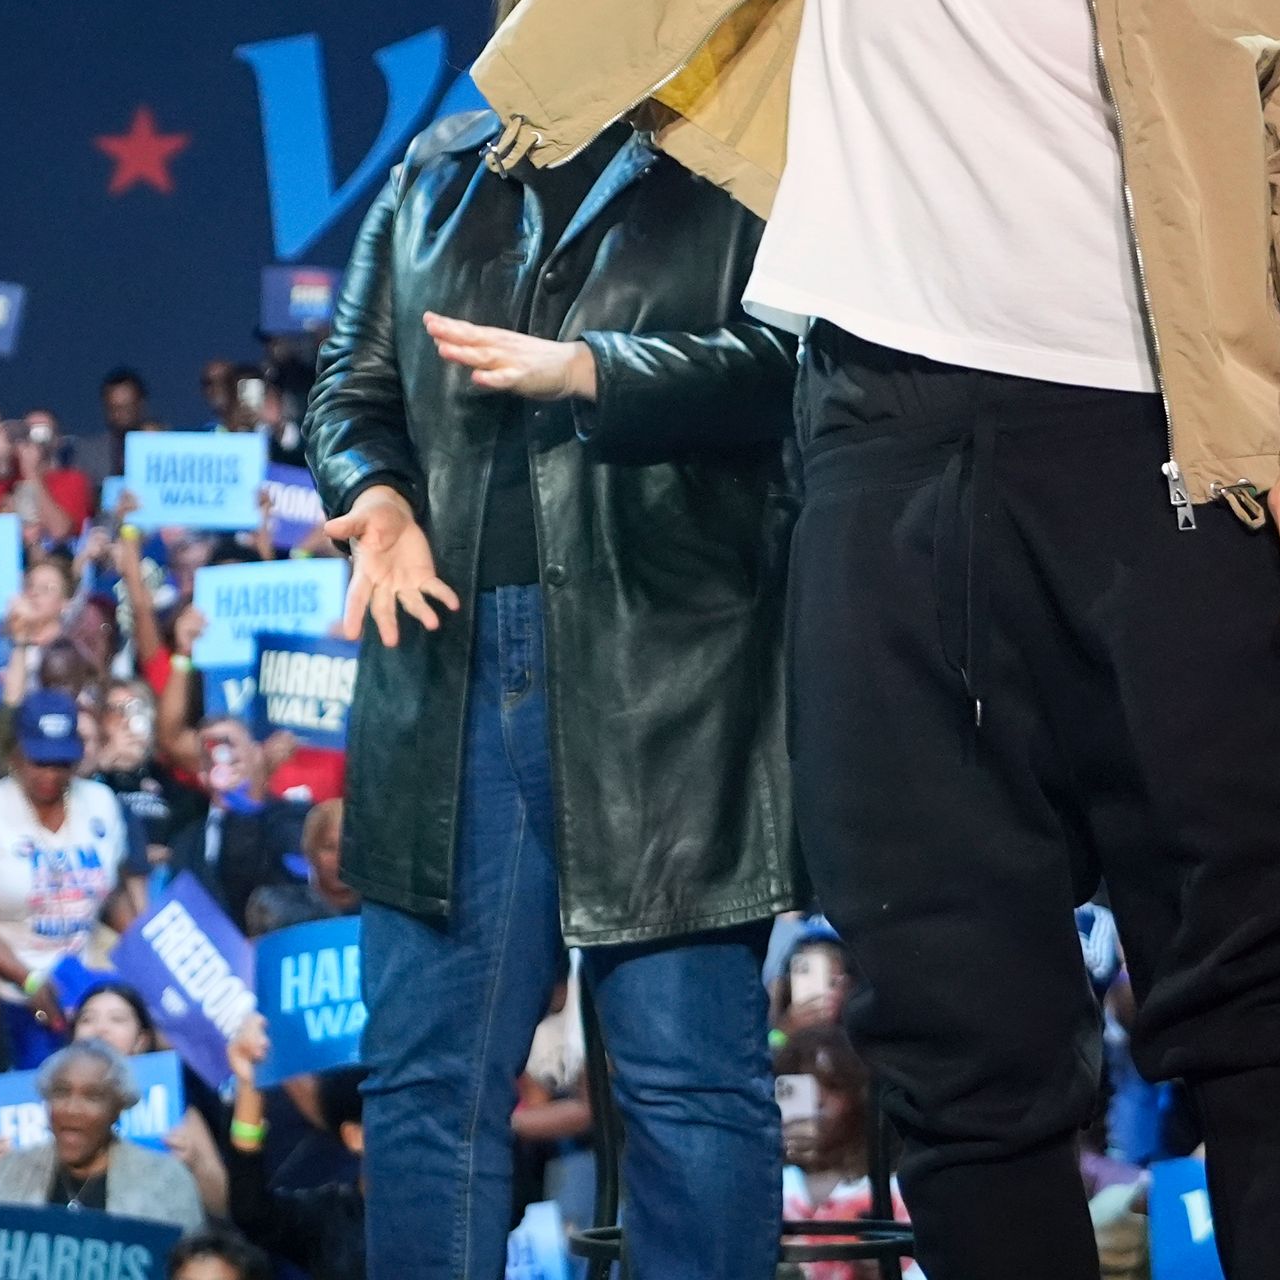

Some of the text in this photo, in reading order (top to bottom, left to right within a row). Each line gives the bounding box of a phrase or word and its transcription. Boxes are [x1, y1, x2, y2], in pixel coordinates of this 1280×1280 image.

[146, 452, 240, 485] HARRIS
[160, 488, 226, 507] WALZ
[215, 580, 319, 619] HARRIS
[259, 649, 359, 706] HARRIS
[266, 693, 344, 732] WALZ
